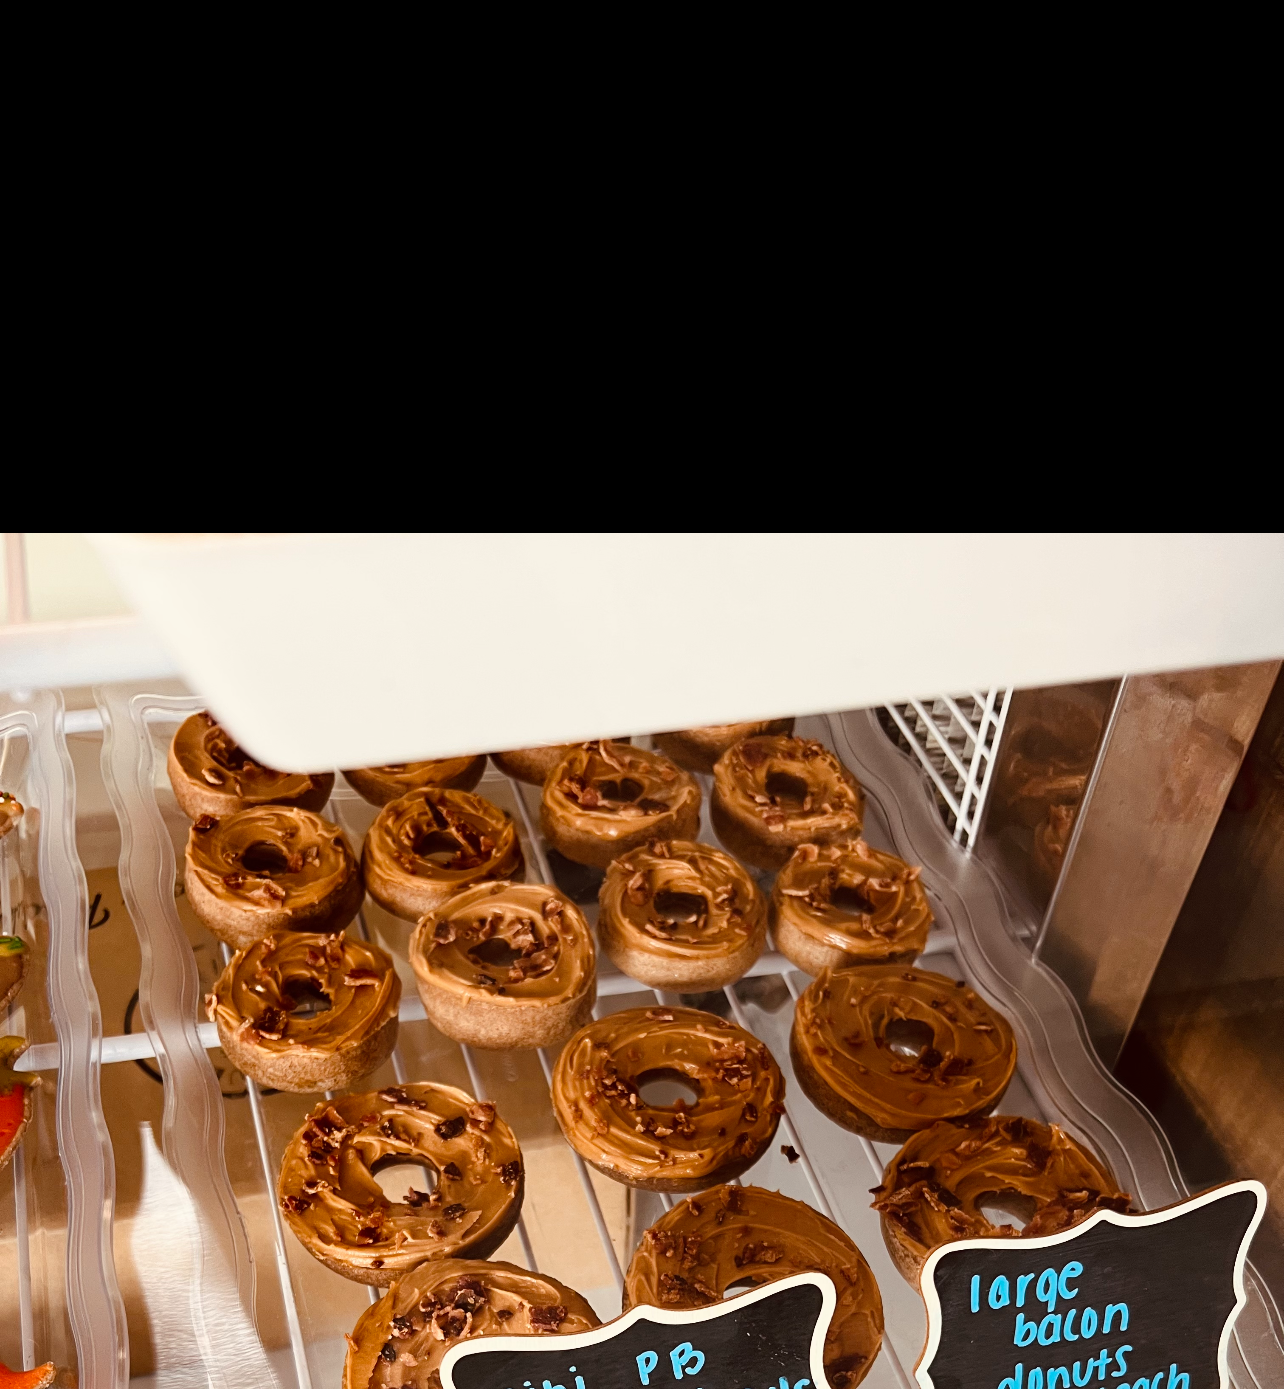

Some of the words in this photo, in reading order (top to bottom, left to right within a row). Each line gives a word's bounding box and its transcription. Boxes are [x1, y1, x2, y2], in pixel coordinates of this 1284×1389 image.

[969, 1260, 1084, 1313] large
[1013, 1302, 1130, 1348] bacon
[635, 1341, 706, 1386] PB
